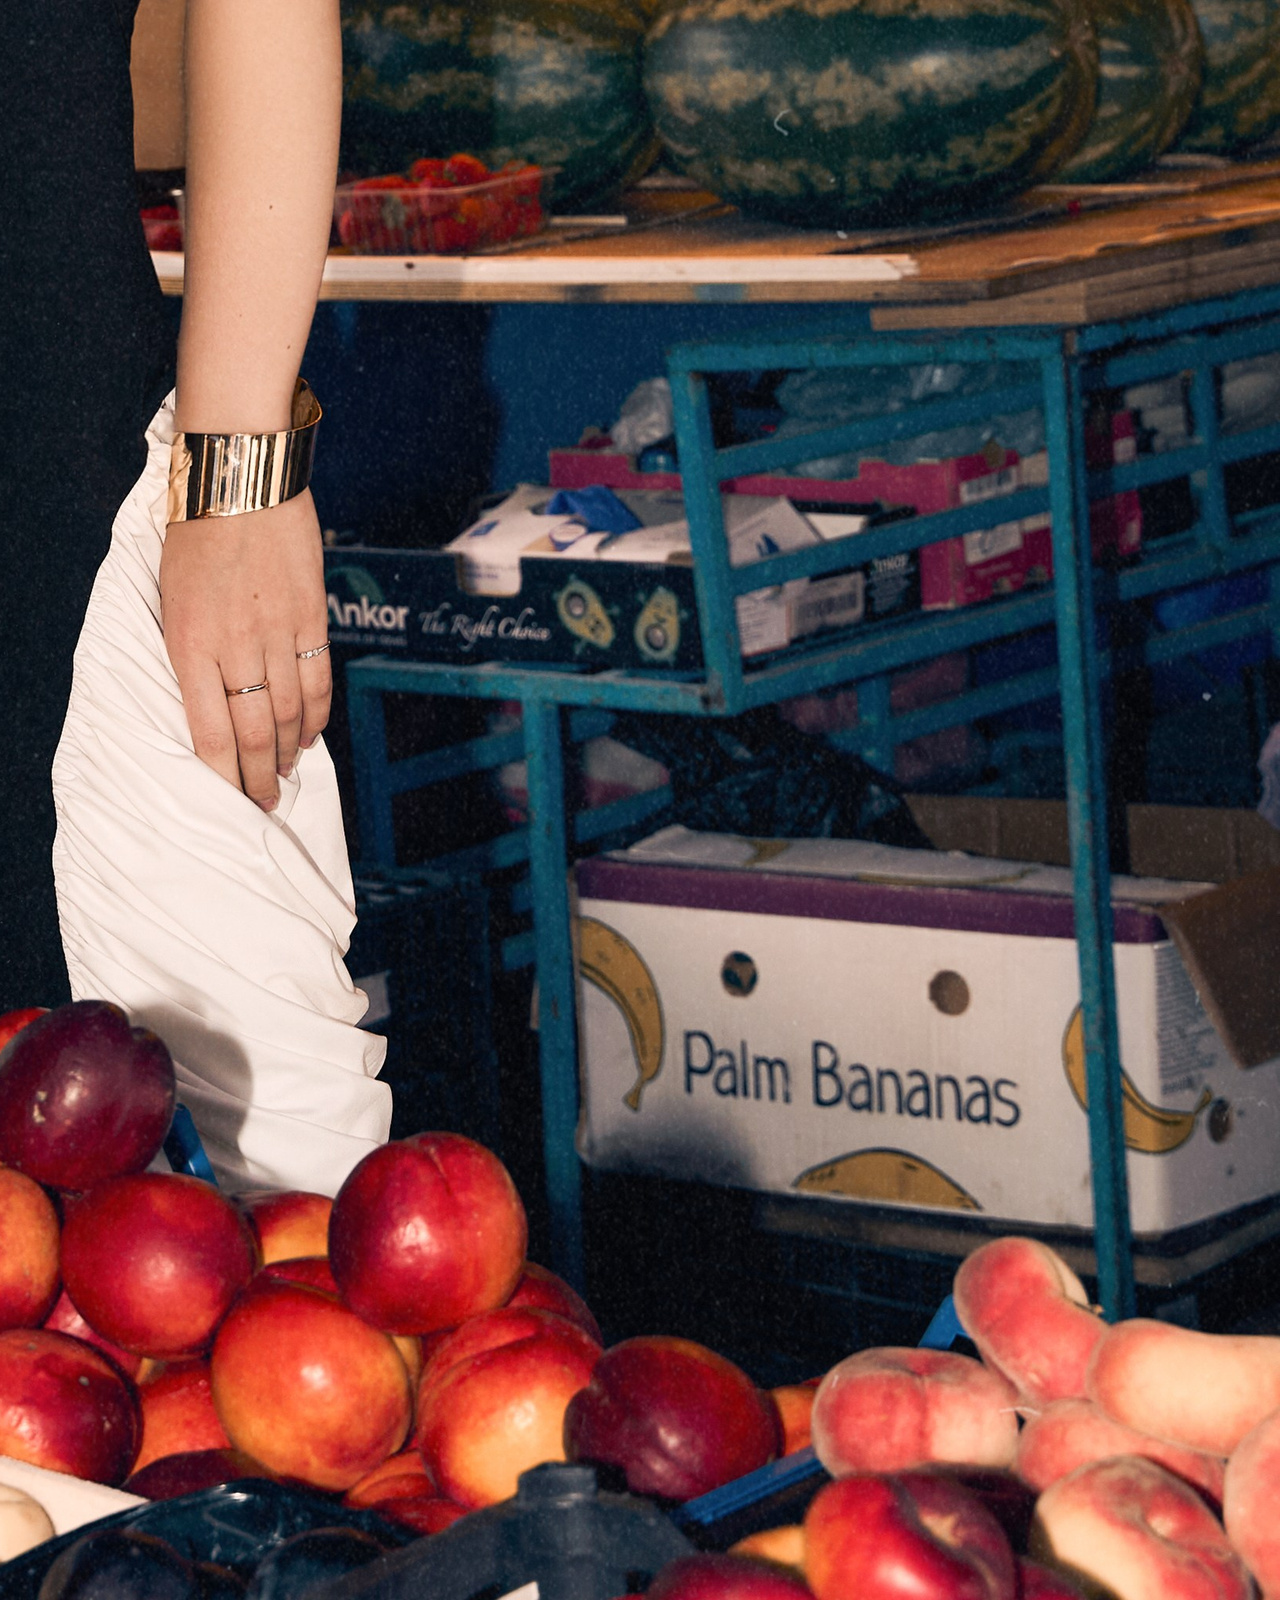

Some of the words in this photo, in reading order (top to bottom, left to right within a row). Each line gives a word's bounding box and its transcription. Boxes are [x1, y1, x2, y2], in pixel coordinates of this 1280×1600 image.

[419, 602, 451, 633] The
[451, 604, 500, 652] Right
[498, 607, 551, 641] Choice
[684, 1030, 791, 1103] Palm
[813, 1040, 1022, 1129] Bananas
